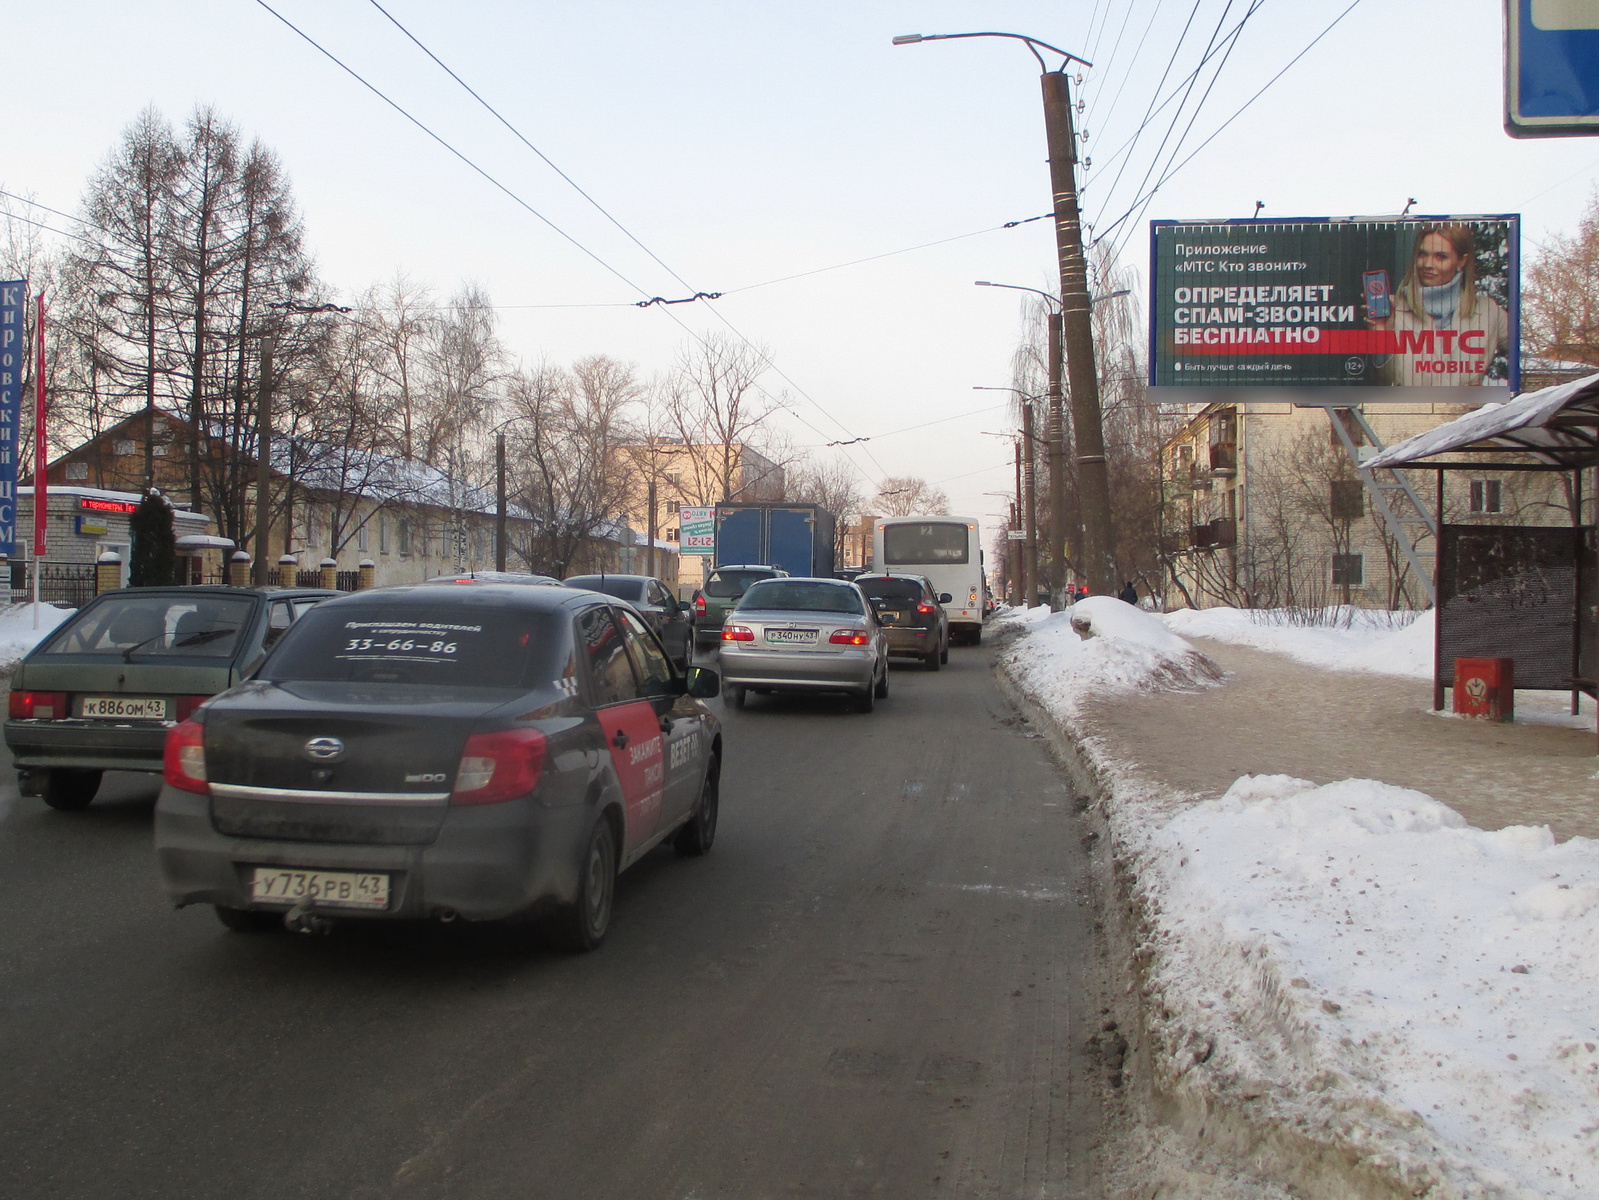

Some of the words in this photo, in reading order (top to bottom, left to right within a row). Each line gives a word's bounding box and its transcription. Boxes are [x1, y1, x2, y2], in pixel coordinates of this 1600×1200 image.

[1175, 244, 1268, 257] Приложение
[1174, 261, 1215, 272] «МТС
[1219, 261, 1244, 272] Кто
[1247, 261, 1307, 271] звонит»
[1174, 285, 1334, 306] ОПРЕДЕЛЯЕТ
[1174, 306, 1355, 324] СПАМ-ЗВОНКИ
[1174, 327, 1320, 344] БЕСПЛАТНО
[1185, 363, 1205, 371] Быть
[1207, 364, 1234, 372] лучше
[1348, 362, 1362, 370] 12+
[1415, 361, 1486, 373] MOBILE
[1, 287, 19, 464] Кировский
[419, 623, 481, 632] водителей
[345, 639, 457, 653] 33-66-86
[88, 701, 144, 716] К886ОМ
[147, 701, 160, 713] 43
[263, 873, 351, 899] У736РВ
[359, 876, 380, 894] 43
